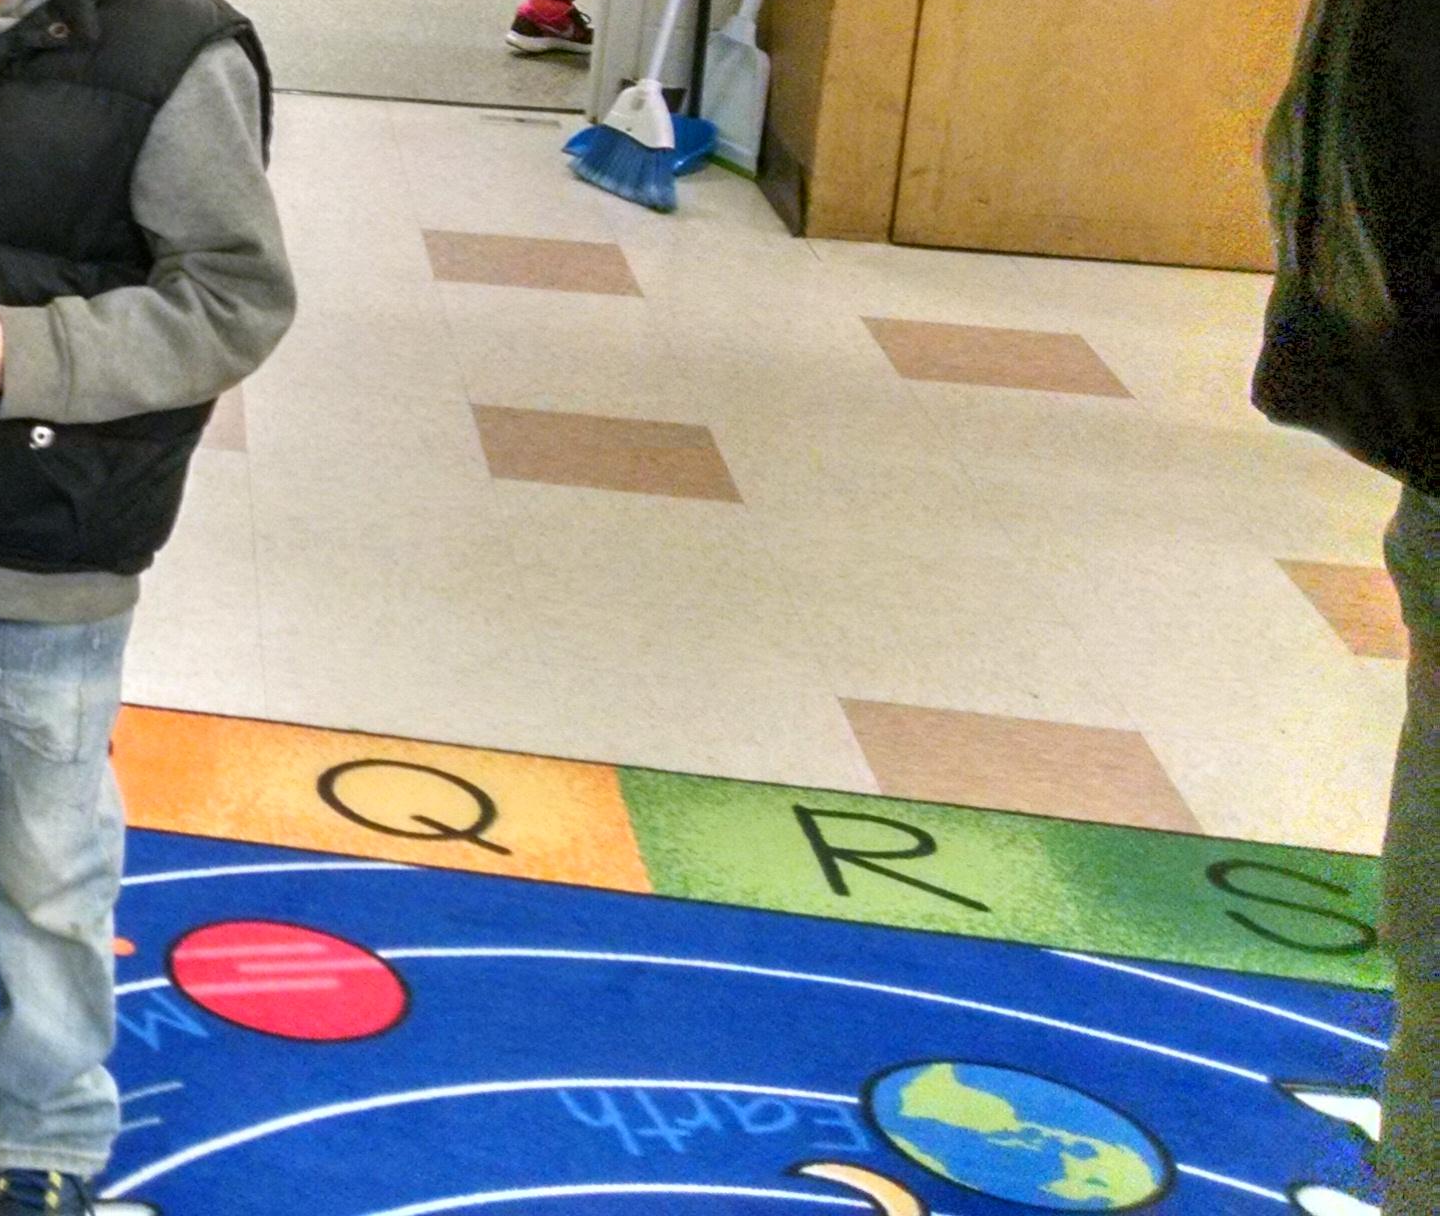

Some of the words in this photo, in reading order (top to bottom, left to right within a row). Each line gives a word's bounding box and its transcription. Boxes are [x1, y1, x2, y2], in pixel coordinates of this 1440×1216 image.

[317, 758, 514, 856] Q
[792, 804, 991, 913] R
[1205, 859, 1380, 955] S
[556, 1086, 872, 1156] Earth
